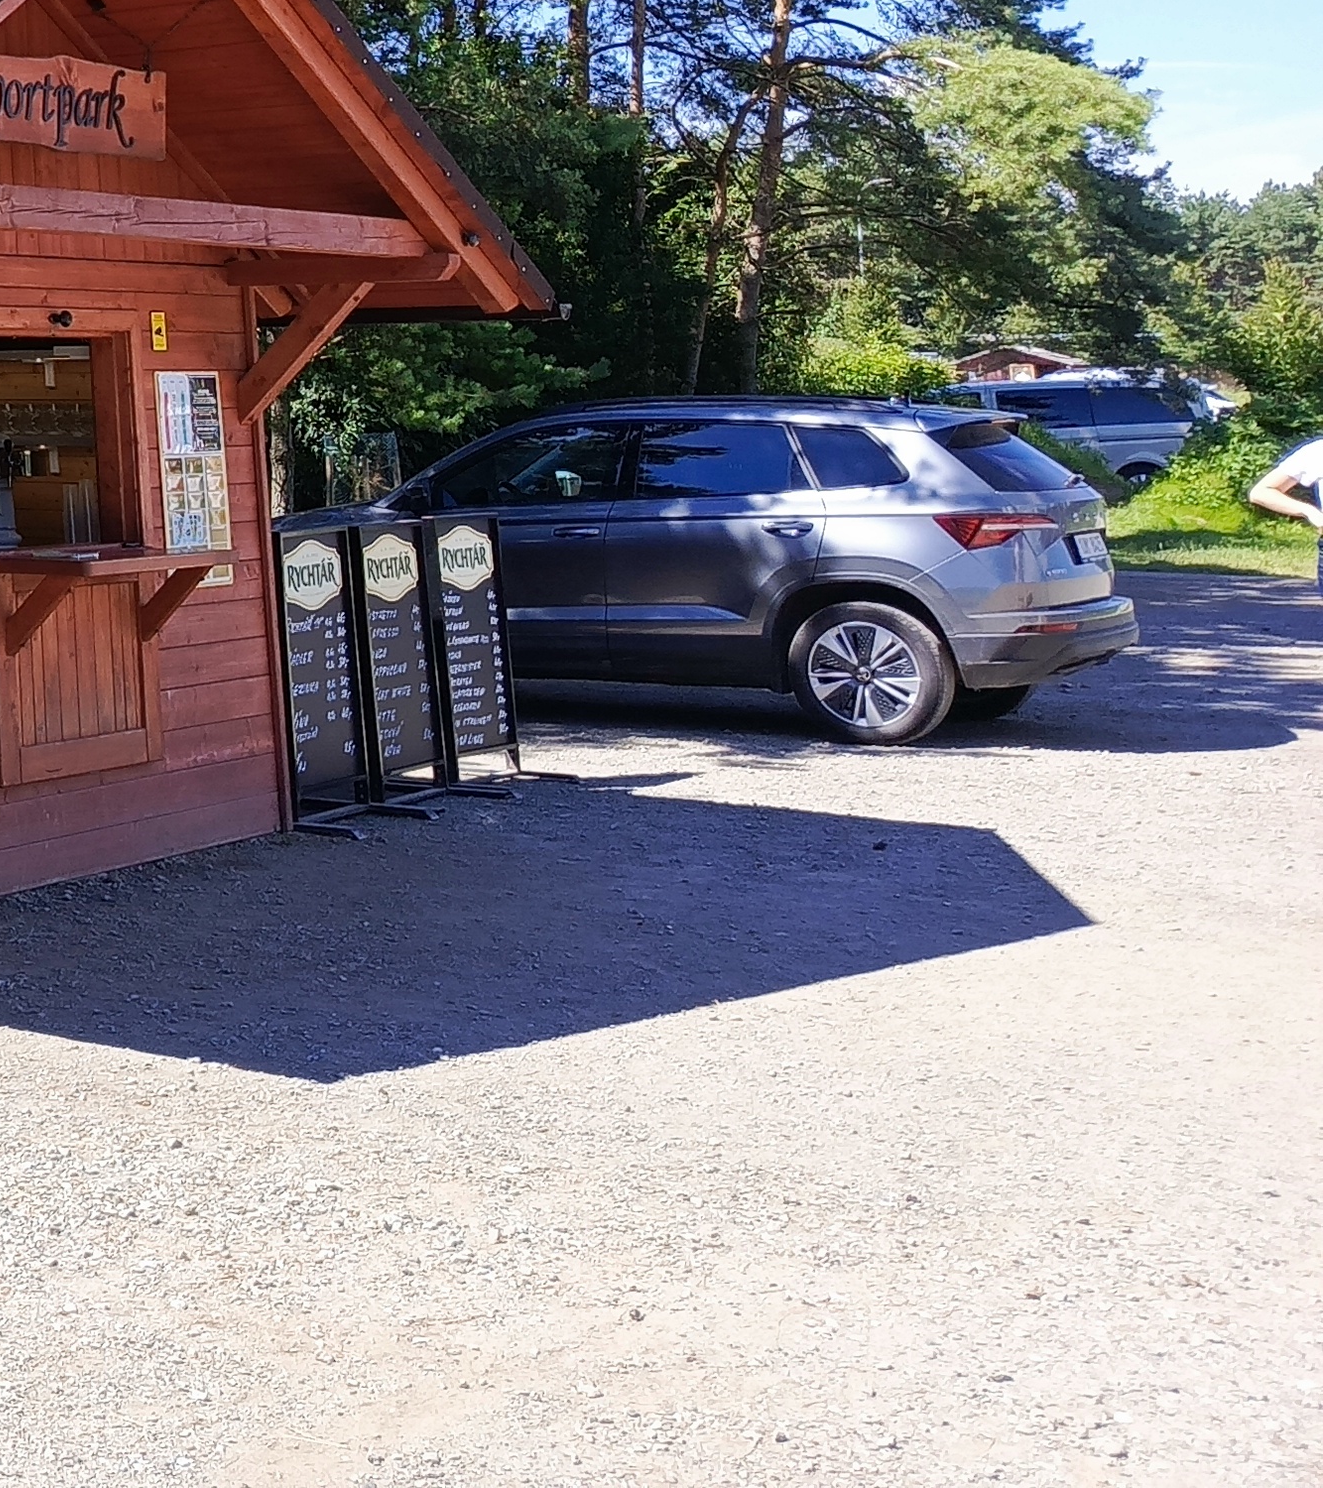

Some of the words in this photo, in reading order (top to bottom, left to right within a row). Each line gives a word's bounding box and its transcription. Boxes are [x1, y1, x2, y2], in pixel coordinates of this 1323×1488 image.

[287, 556, 339, 592] RYCHTÁŘ
[367, 551, 416, 584] RYCHTÁŘ
[441, 542, 491, 573] RYCHTÁŘ
